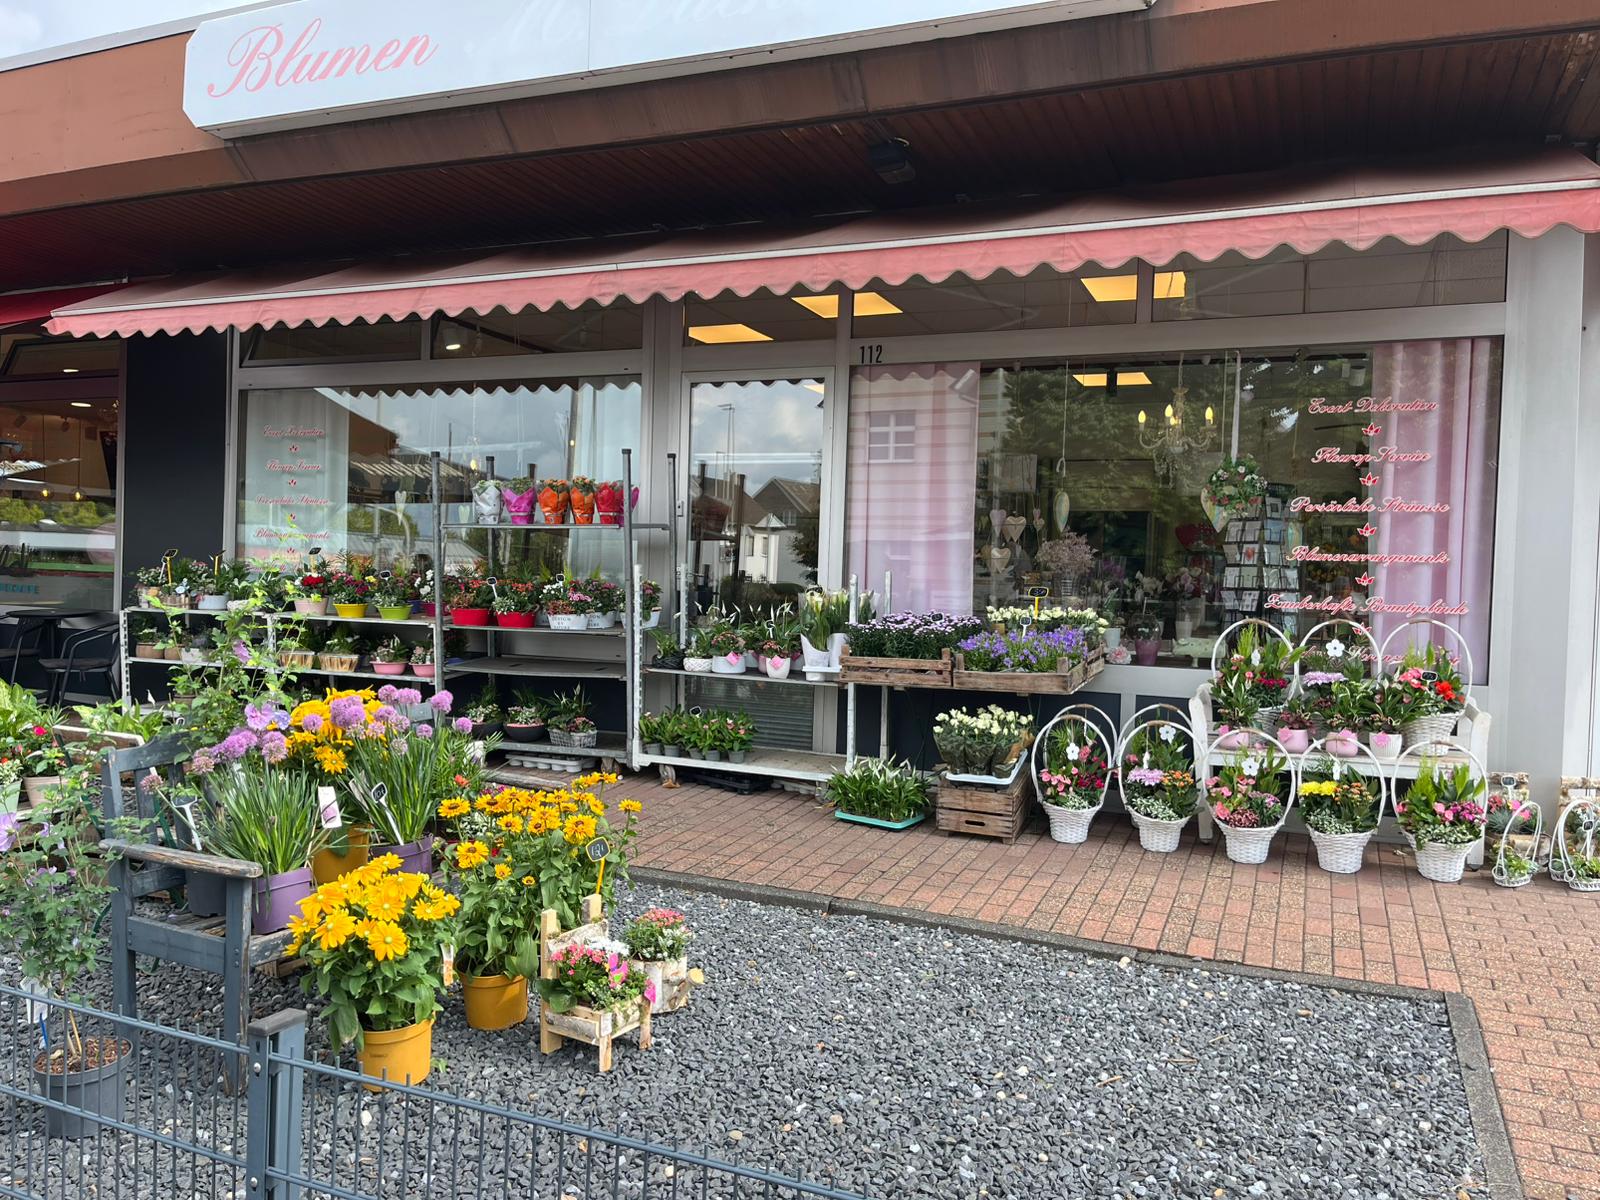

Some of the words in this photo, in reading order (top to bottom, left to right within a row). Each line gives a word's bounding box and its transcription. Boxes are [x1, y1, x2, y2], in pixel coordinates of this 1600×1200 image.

[207, 18, 439, 98] Blumen
[859, 344, 883, 364] 112
[1308, 397, 1353, 414] Event
[1354, 396, 1439, 413] Dekoration
[1311, 446, 1373, 467] Fleurop
[1373, 446, 1432, 462] Service
[1289, 496, 1377, 513] Persönliche
[1377, 496, 1451, 513] Sträusse
[1286, 545, 1451, 567] Blumenarrangements
[1264, 594, 1357, 616] Zauberhafte
[1359, 596, 1470, 618] Brautgebinde
